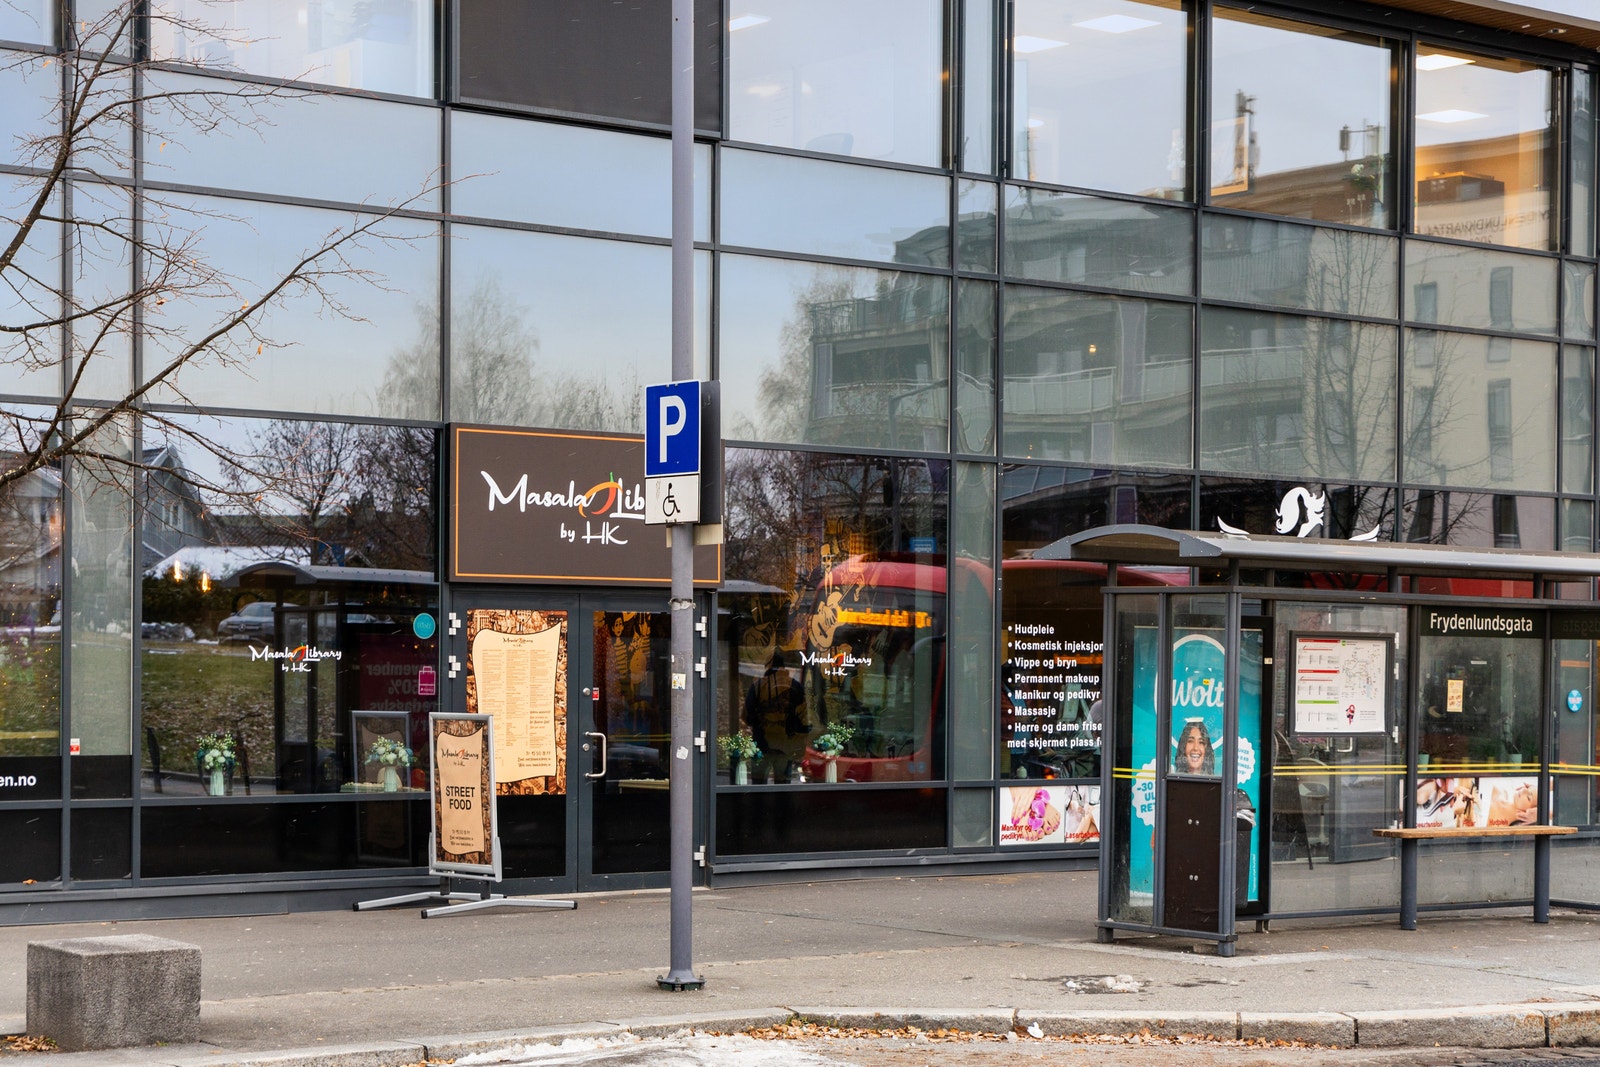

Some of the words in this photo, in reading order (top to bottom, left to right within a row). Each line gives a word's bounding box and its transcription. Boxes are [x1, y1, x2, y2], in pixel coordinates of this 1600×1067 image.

[659, 395, 687, 463] P
[480, 470, 596, 512] Masala
[560, 522, 575, 542] by
[581, 521, 628, 545] HK
[1430, 612, 1533, 634] Frydenlundsgata
[1014, 624, 1055, 637] Hudpleie
[1014, 640, 1062, 651] Kosmetisk
[248, 644, 297, 662] Masala
[302, 644, 342, 662] Library
[799, 650, 838, 666] Masala
[840, 651, 872, 667] Library
[281, 663, 289, 673] by
[291, 662, 312, 673] HK
[1014, 657, 1041, 669] Vippe
[1043, 659, 1055, 670] og
[1057, 657, 1077, 669] bryn
[831, 667, 848, 676] HK
[1014, 673, 1063, 683] Permanent
[1065, 673, 1100, 685] makeup
[1014, 690, 1051, 700] Manikur
[1053, 691, 1065, 702] og
[1067, 689, 1100, 702] pedikyr
[1172, 677, 1224, 708] Wolt
[1014, 706, 1056, 717] Massasje
[1014, 722, 1040, 732] Herre
[1042, 724, 1053, 733] og
[1056, 721, 1079, 731] dame
[1007, 738, 1026, 748] med
[1029, 737, 1068, 749] skjermet
[1070, 737, 1094, 749] plass
[445, 785, 476, 798] STREET
[449, 799, 472, 811] FOOD
[1140, 803, 1156, 814] RE
